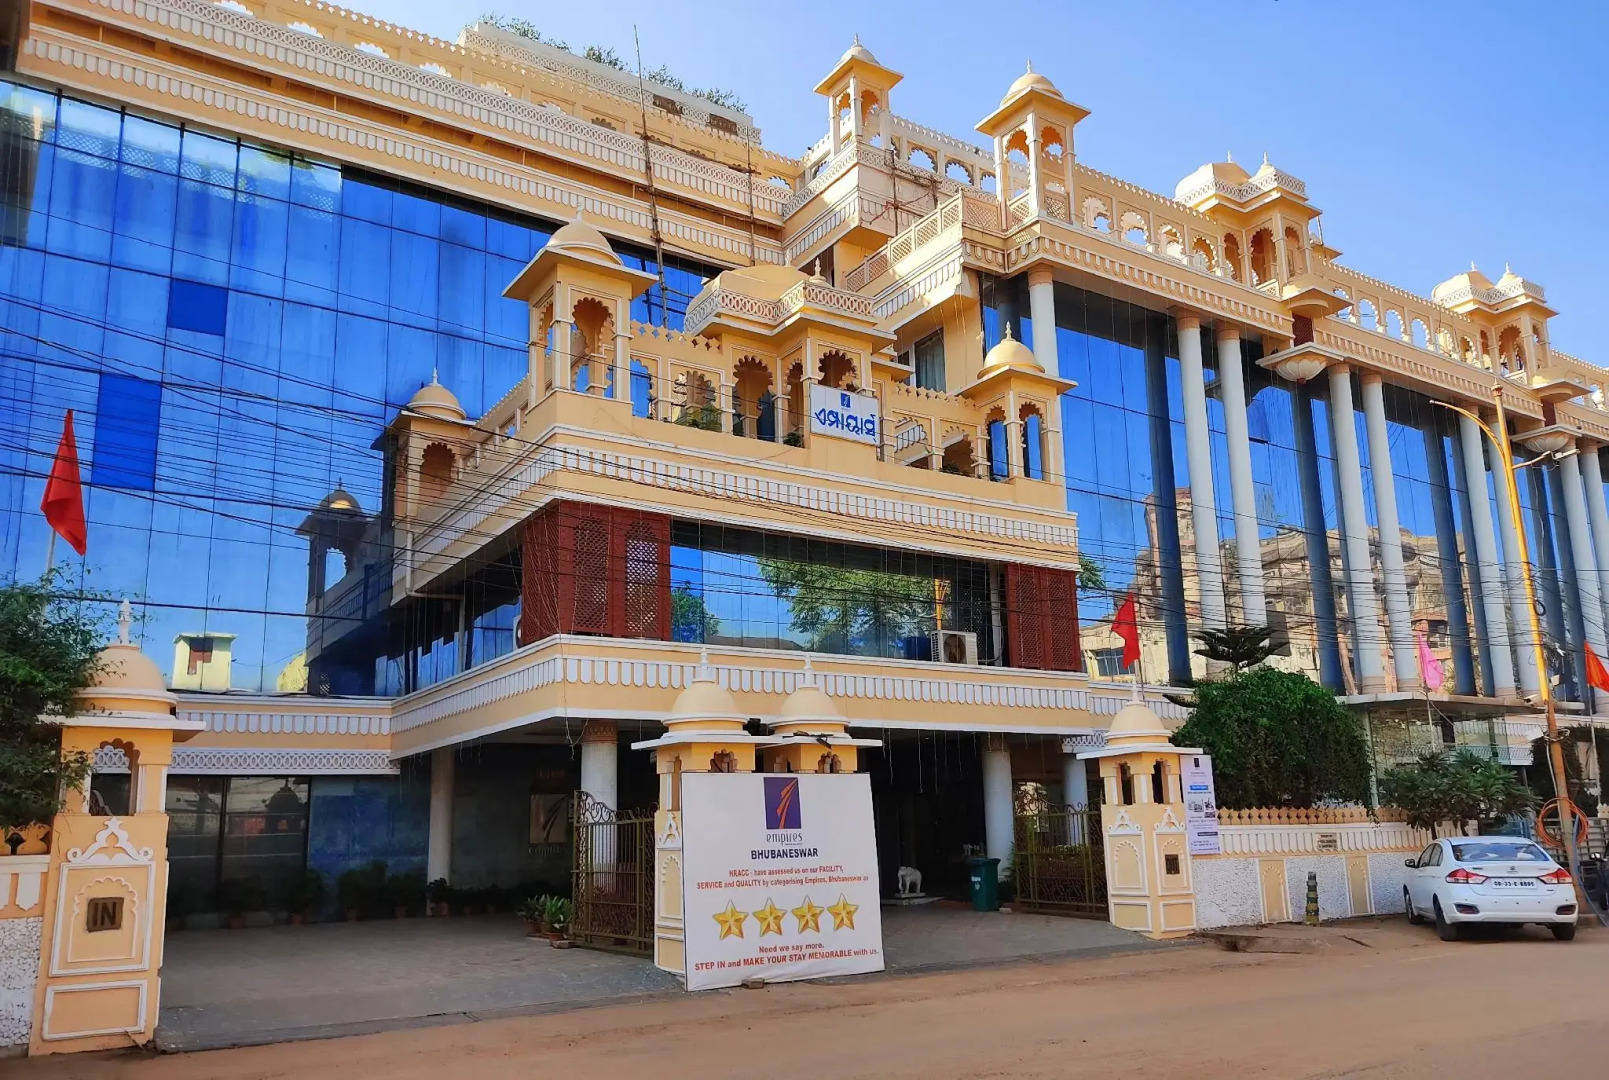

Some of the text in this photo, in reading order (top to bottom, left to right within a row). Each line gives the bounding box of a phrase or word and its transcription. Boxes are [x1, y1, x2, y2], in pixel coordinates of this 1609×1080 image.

[766, 830, 803, 846] empires
[750, 847, 819, 860] BHUBANESWAR
[753, 868, 767, 876] have
[768, 867, 793, 876] assessed
[819, 864, 844, 873] FACILITY,
[696, 880, 723, 890] SERVICE
[724, 880, 735, 888] and
[735, 879, 761, 888] QUALITY
[762, 879, 769, 887] by
[770, 876, 803, 886] categorising
[804, 876, 828, 885] Empires,
[828, 874, 862, 883] Bhubaneswar
[92, 901, 117, 927] IN
[758, 944, 777, 953] Need
[791, 944, 804, 952] say
[805, 942, 825, 950] more.
[694, 961, 715, 971] STEP
[717, 960, 726, 969] IN
[727, 958, 742, 968] and
[743, 956, 765, 966] MAKE
[766, 955, 787, 964] YOUR
[788, 952, 807, 962] STAY
[808, 949, 852, 960] MEMORABLE
[853, 948, 868, 956] with
